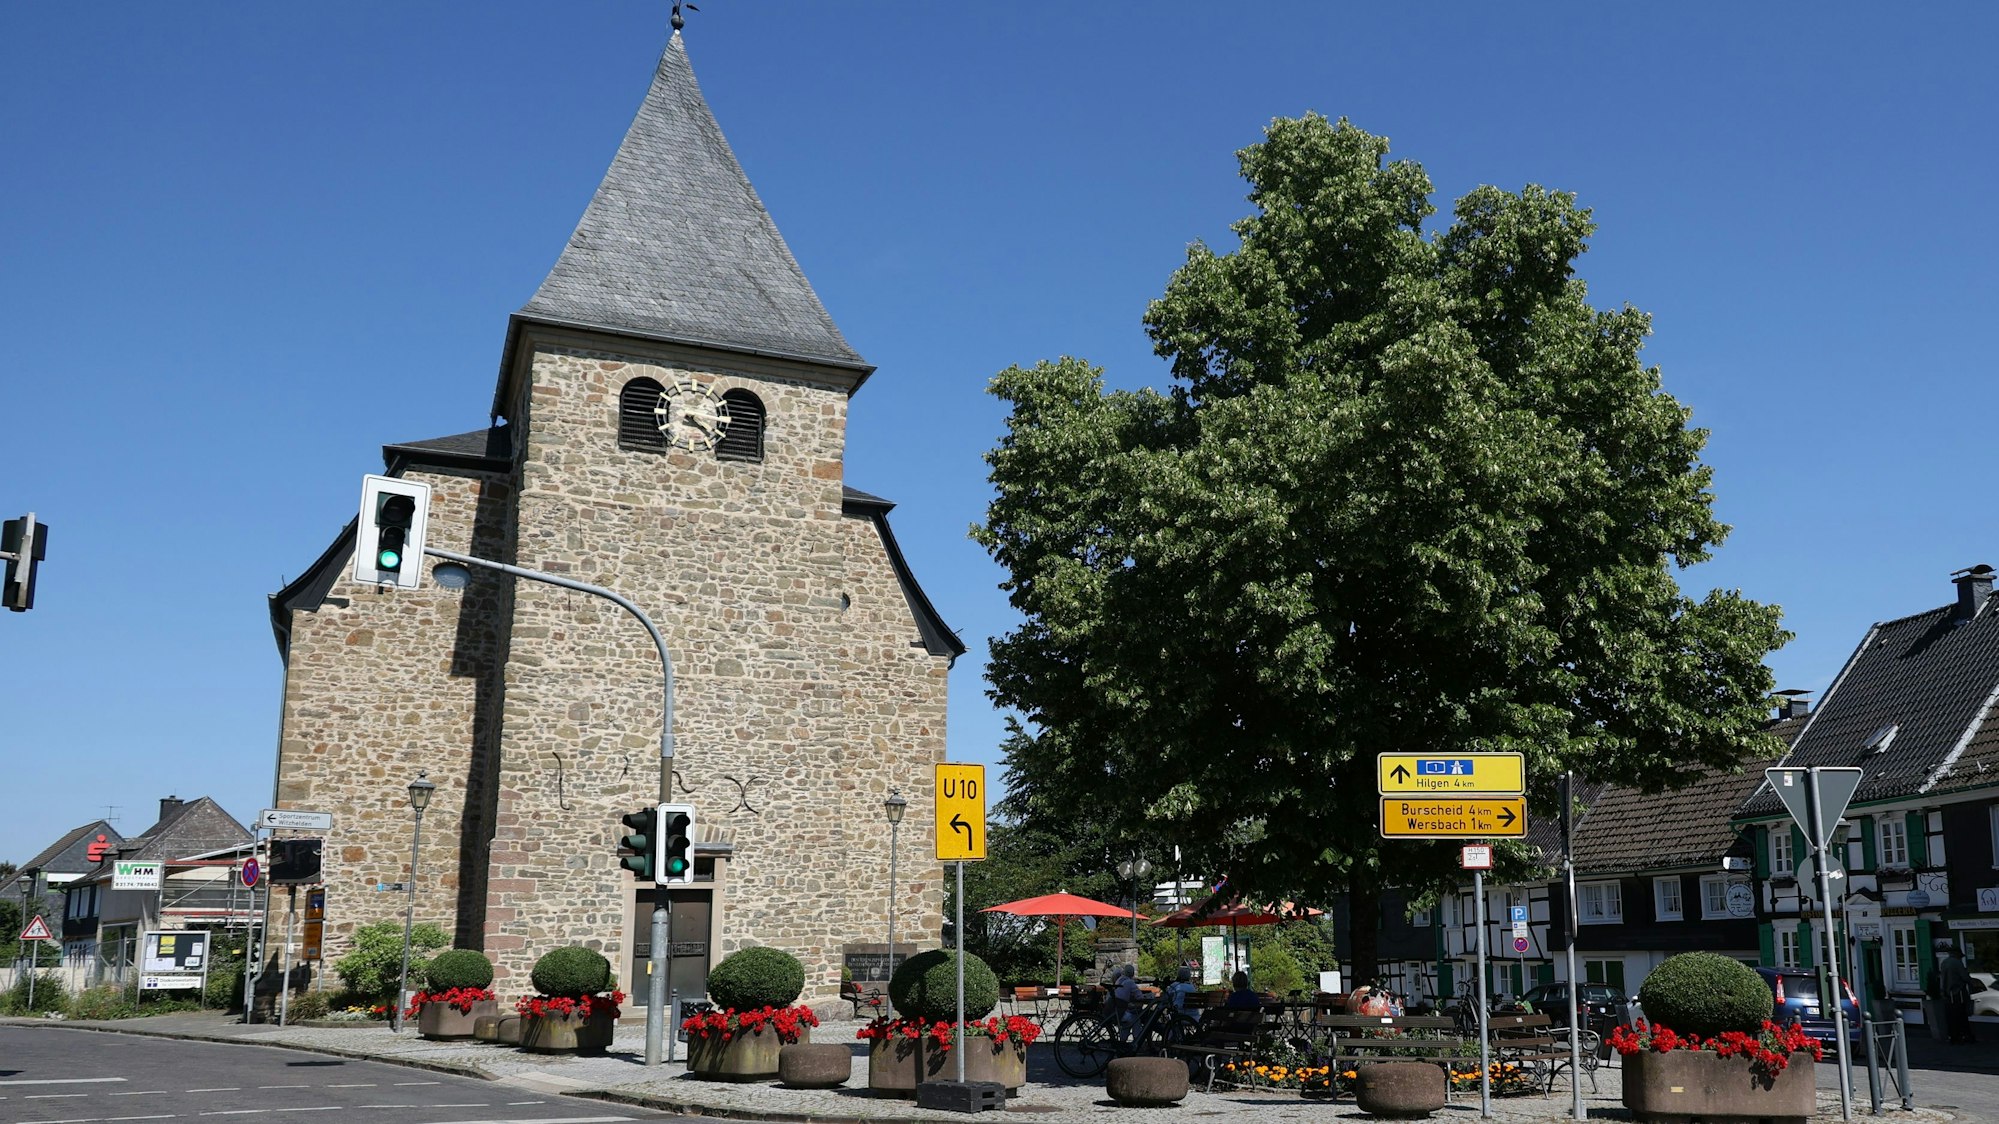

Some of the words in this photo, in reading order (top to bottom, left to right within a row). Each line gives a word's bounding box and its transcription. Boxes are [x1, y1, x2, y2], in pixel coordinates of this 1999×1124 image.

[943, 778, 956, 799] U
[959, 779, 977, 800] 10
[1416, 778, 1449, 790] Hilgen
[1454, 779, 1460, 788] 4
[1462, 780, 1475, 788] km
[1401, 803, 1463, 816] Burscheid
[1468, 804, 1476, 816] 4
[1477, 807, 1492, 816] km
[278, 813, 321, 821] Sportzentrum
[1407, 818, 1466, 830] Wersbach
[1471, 818, 1476, 830] 1
[1478, 820, 1492, 830] km
[117, 863, 154, 876] WHM
[1515, 908, 1524, 920] P
